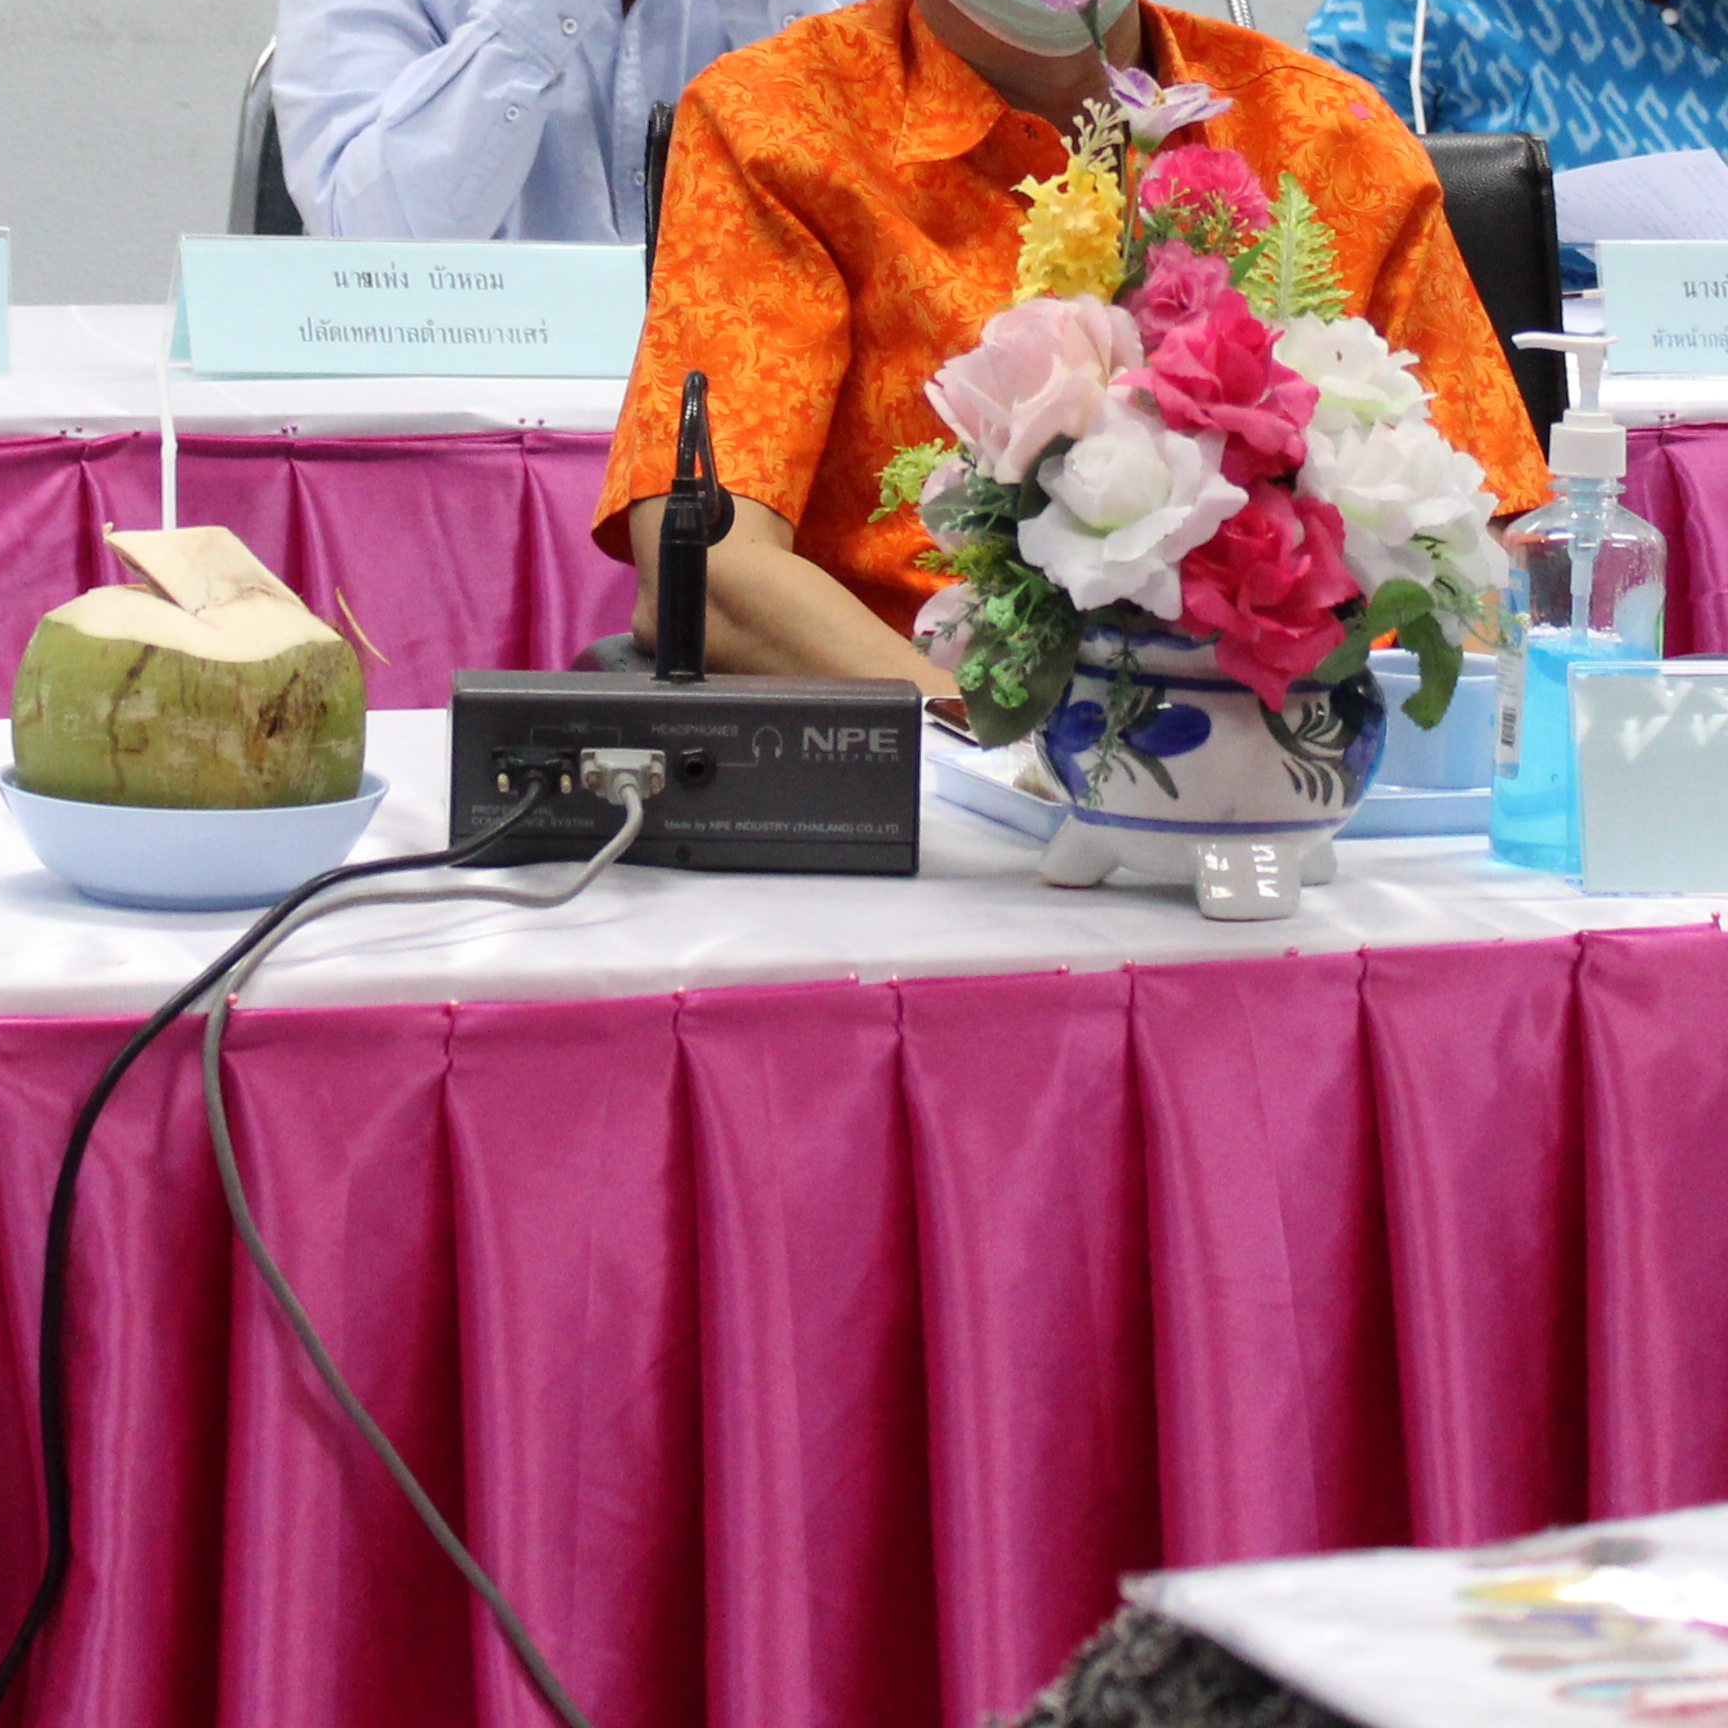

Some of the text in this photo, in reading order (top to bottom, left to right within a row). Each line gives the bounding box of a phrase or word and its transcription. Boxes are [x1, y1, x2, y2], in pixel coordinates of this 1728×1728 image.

[427, 264, 506, 291] บัวหอม
[298, 315, 550, 345] ปลัดเทศบาลตำบลบางเสร่
[651, 722, 739, 739] HEADPHONES
[802, 726, 900, 753] NPE
[708, 819, 732, 832] NPE
[734, 819, 792, 833] INDUSTRY
